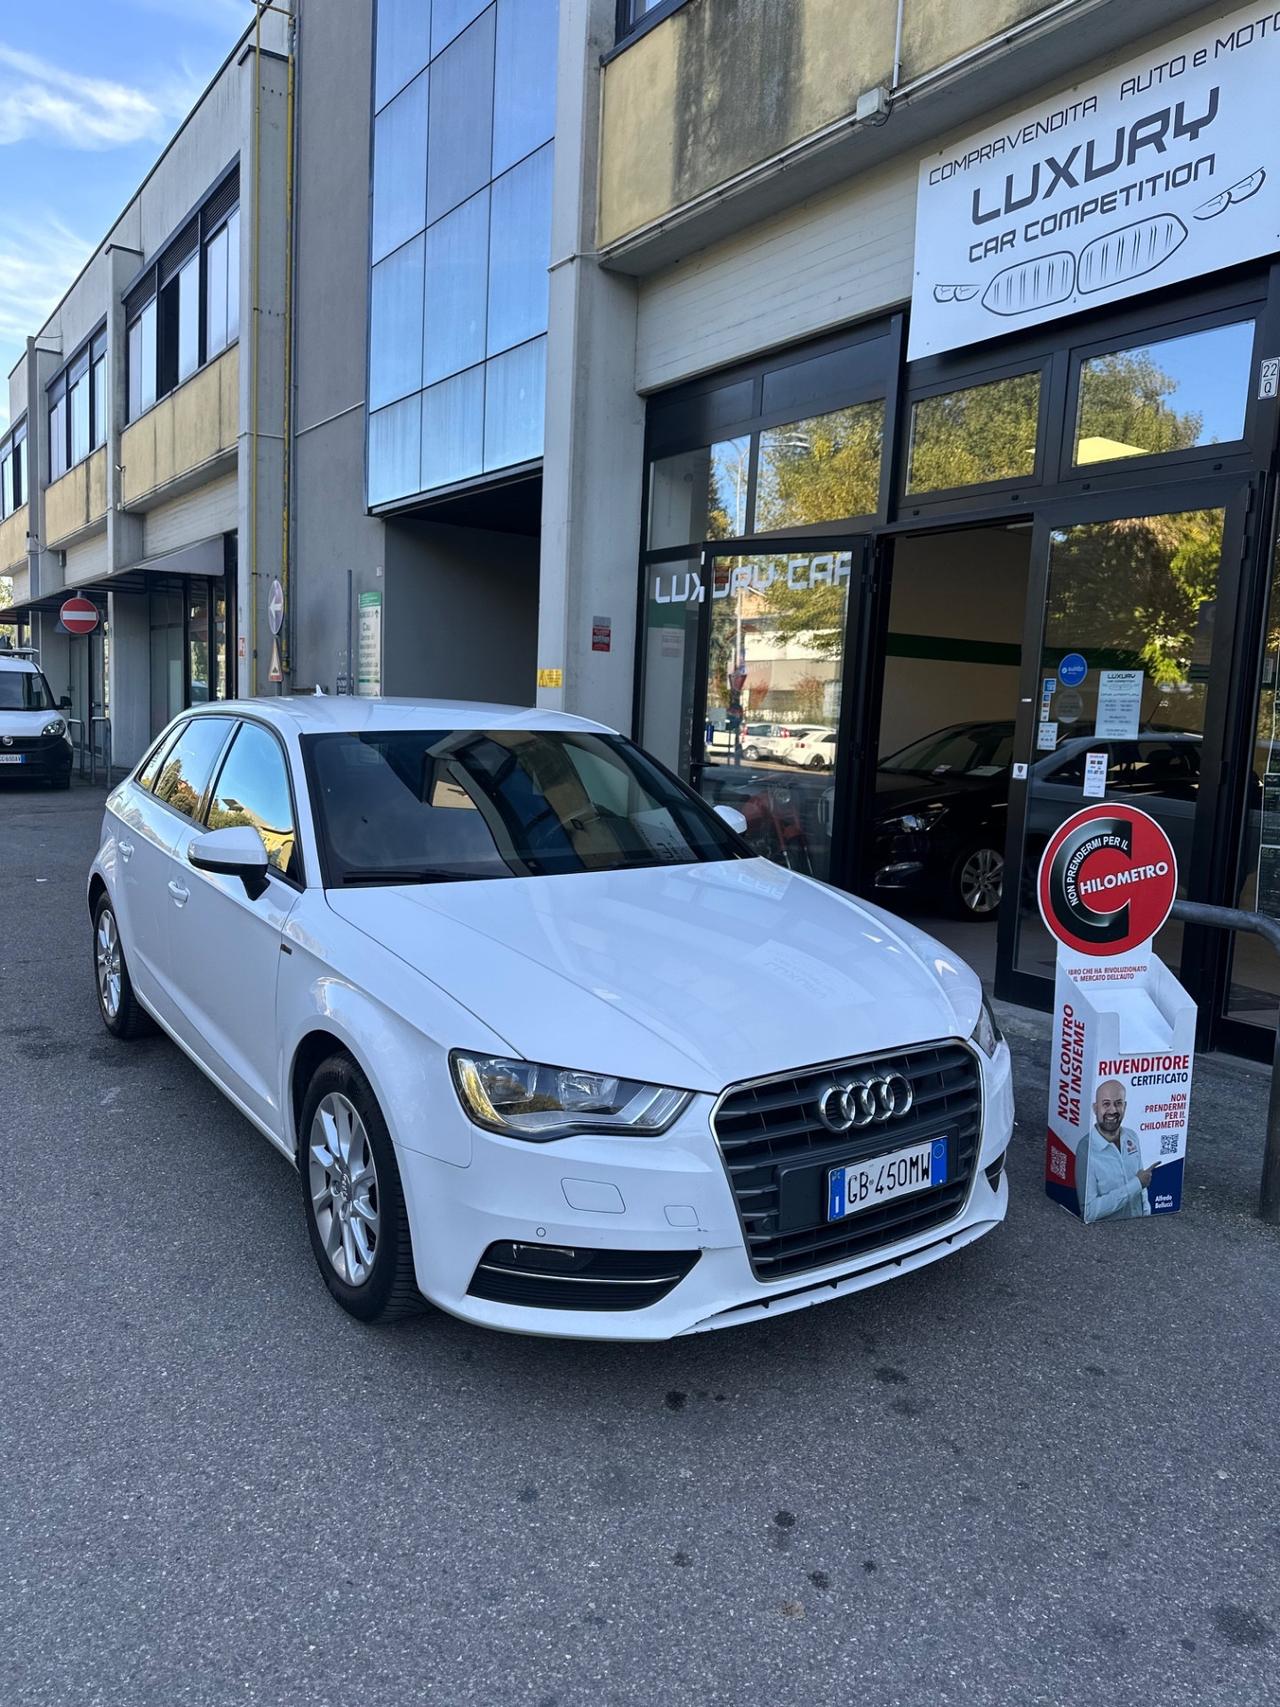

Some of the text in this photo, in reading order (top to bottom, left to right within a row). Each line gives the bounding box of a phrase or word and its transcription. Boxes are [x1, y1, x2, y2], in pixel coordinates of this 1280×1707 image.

[929, 96, 1097, 186] COMPRAVENDITA
[1120, 55, 1185, 100] AUTO
[1193, 48, 1207, 68] e
[971, 86, 1220, 225] LUXURY
[968, 153, 1216, 263] CAR COMPETITION
[1263, 363, 1277, 378] 22
[1066, 836, 1129, 906] NON PRENDERMI PER IL
[1104, 965, 1147, 974] RIVOLUZIONATO
[1080, 974, 1106, 982] MERCATO
[1106, 973, 1134, 981] DELL'AUTO
[1057, 1003, 1074, 1120] NON CONTRO
[1098, 1055, 1190, 1076] RIVENDITORE
[1068, 1019, 1085, 1127] MA INSIEME
[1131, 1072, 1188, 1086] CERTIFICATO
[1170, 1093, 1186, 1102] NON
[1145, 1102, 1186, 1113] PRENDERMI
[1165, 1111, 1186, 1120] PER IL
[1140, 1119, 1185, 1131] CHILOMETRO
